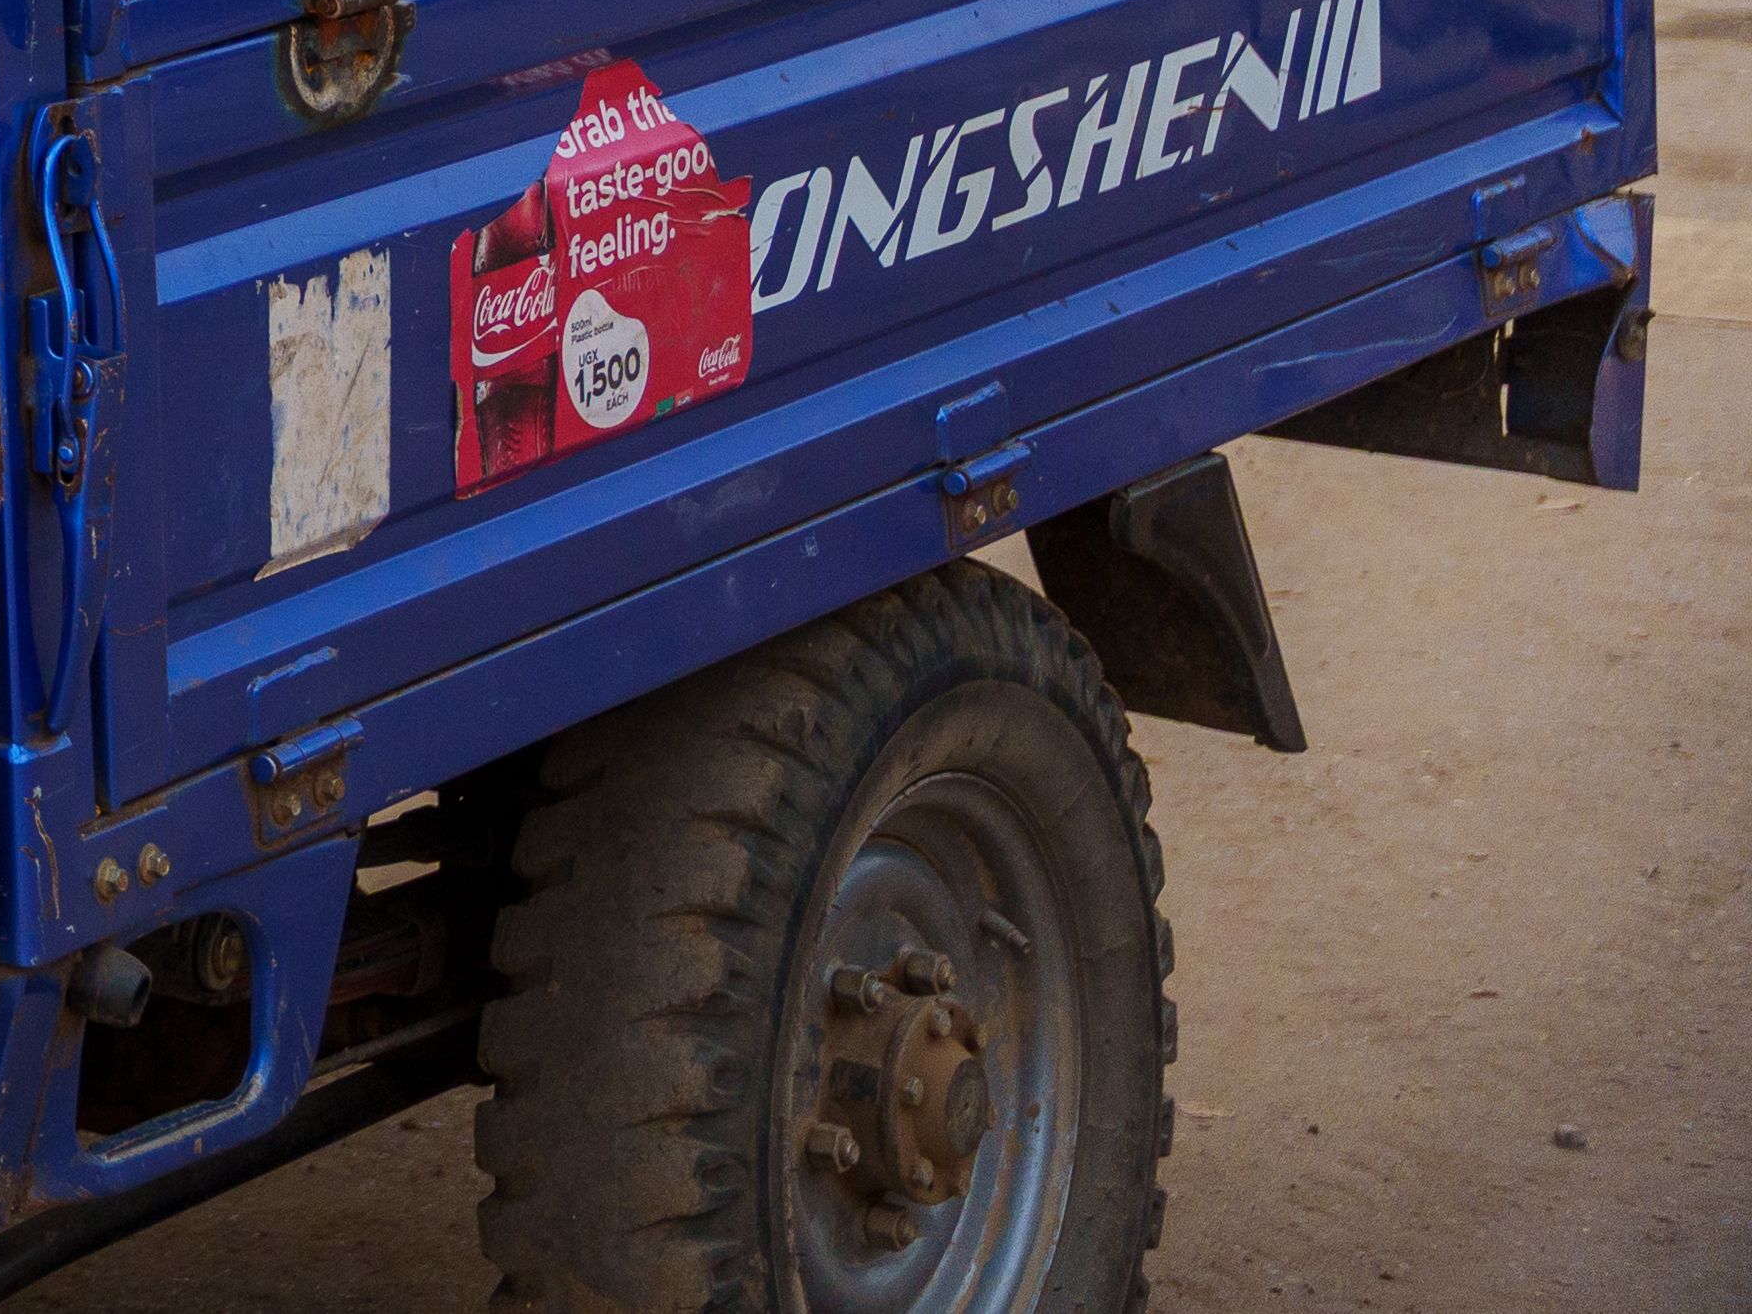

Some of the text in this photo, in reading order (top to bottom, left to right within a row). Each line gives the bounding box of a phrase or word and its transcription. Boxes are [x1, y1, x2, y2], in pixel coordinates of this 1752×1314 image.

[566, 142, 716, 219] taste-goo
[748, 8, 1302, 315] ONGSHEN
[568, 210, 676, 279] feeling.
[474, 264, 555, 341] Coca-Cola
[574, 347, 641, 408] 1,500
[578, 348, 599, 368] UGX
